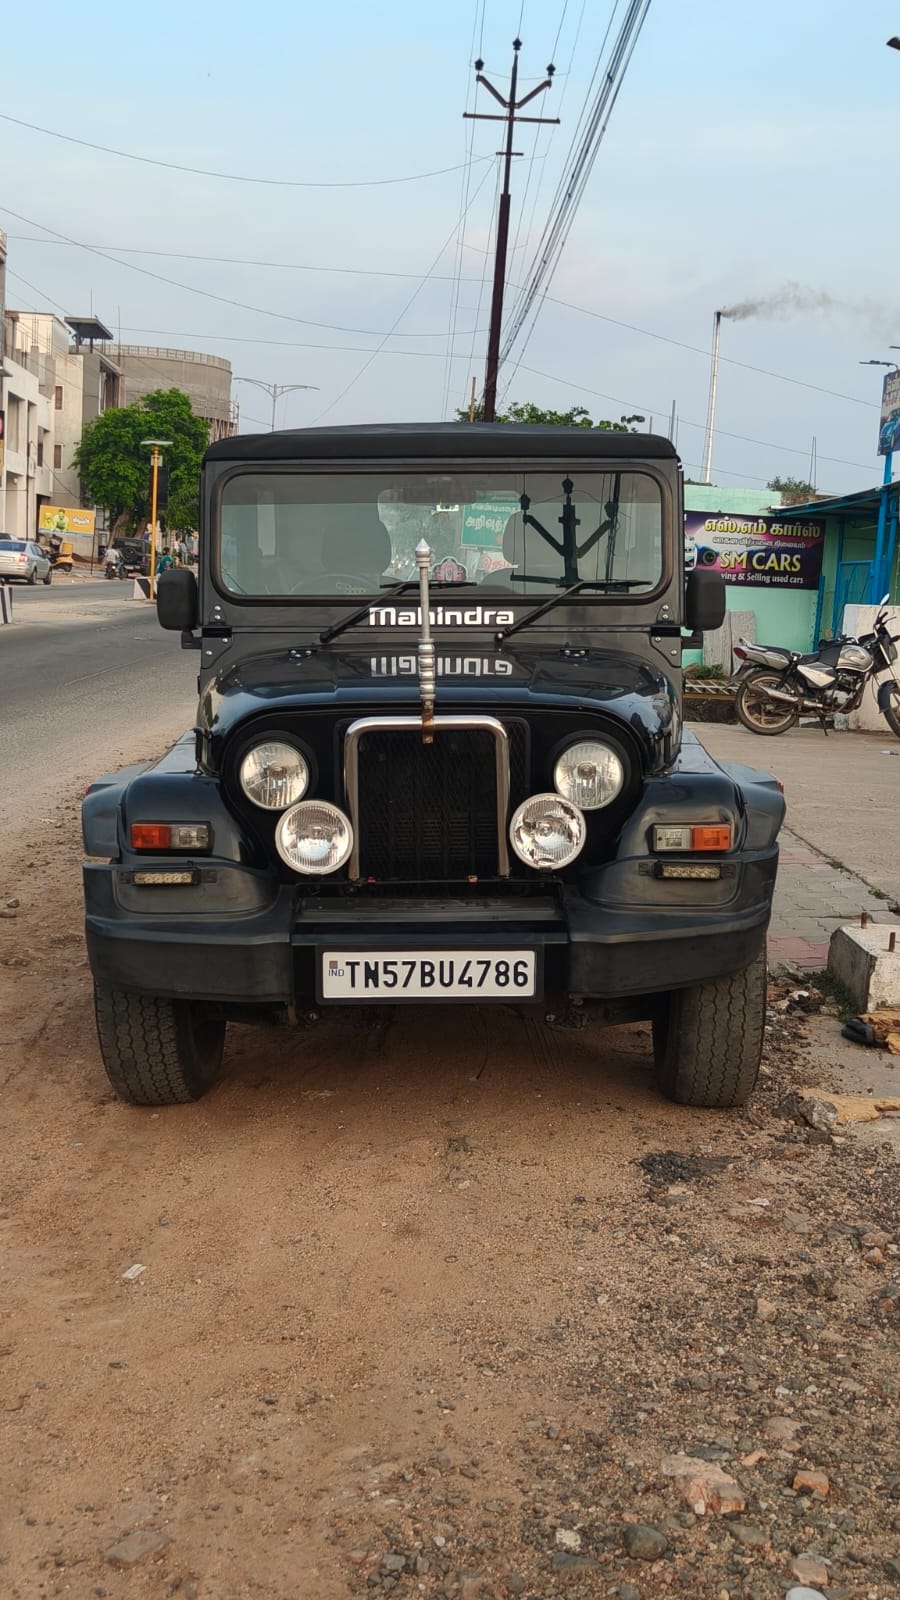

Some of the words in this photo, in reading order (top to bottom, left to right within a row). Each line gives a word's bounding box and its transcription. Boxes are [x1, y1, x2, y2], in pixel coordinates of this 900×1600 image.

[720, 550, 748, 569] SM
[752, 552, 801, 572] CARS
[737, 572, 745, 580] &
[747, 572, 771, 584] Selling
[772, 573, 788, 583] used
[789, 575, 804, 584] cars
[328, 968, 344, 977] IND
